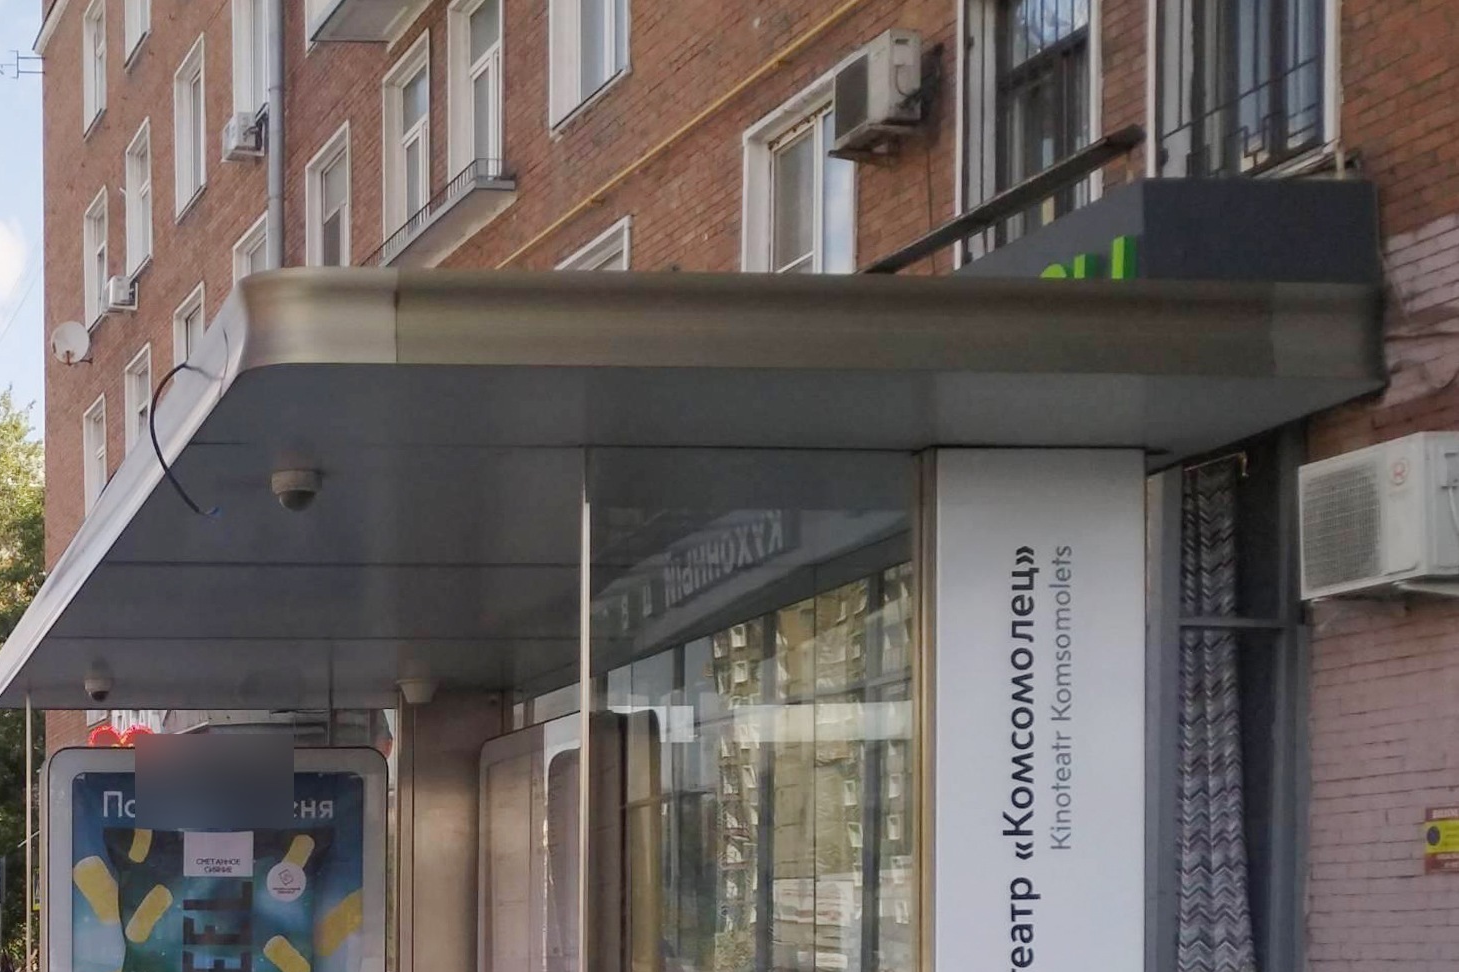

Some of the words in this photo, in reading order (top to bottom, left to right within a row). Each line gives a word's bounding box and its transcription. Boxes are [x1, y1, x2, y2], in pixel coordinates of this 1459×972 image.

[1002, 545, 1040, 860] «Комсомолец»
[1048, 545, 1072, 721] Komsomolets
[1049, 730, 1072, 850] Kinoteatr
